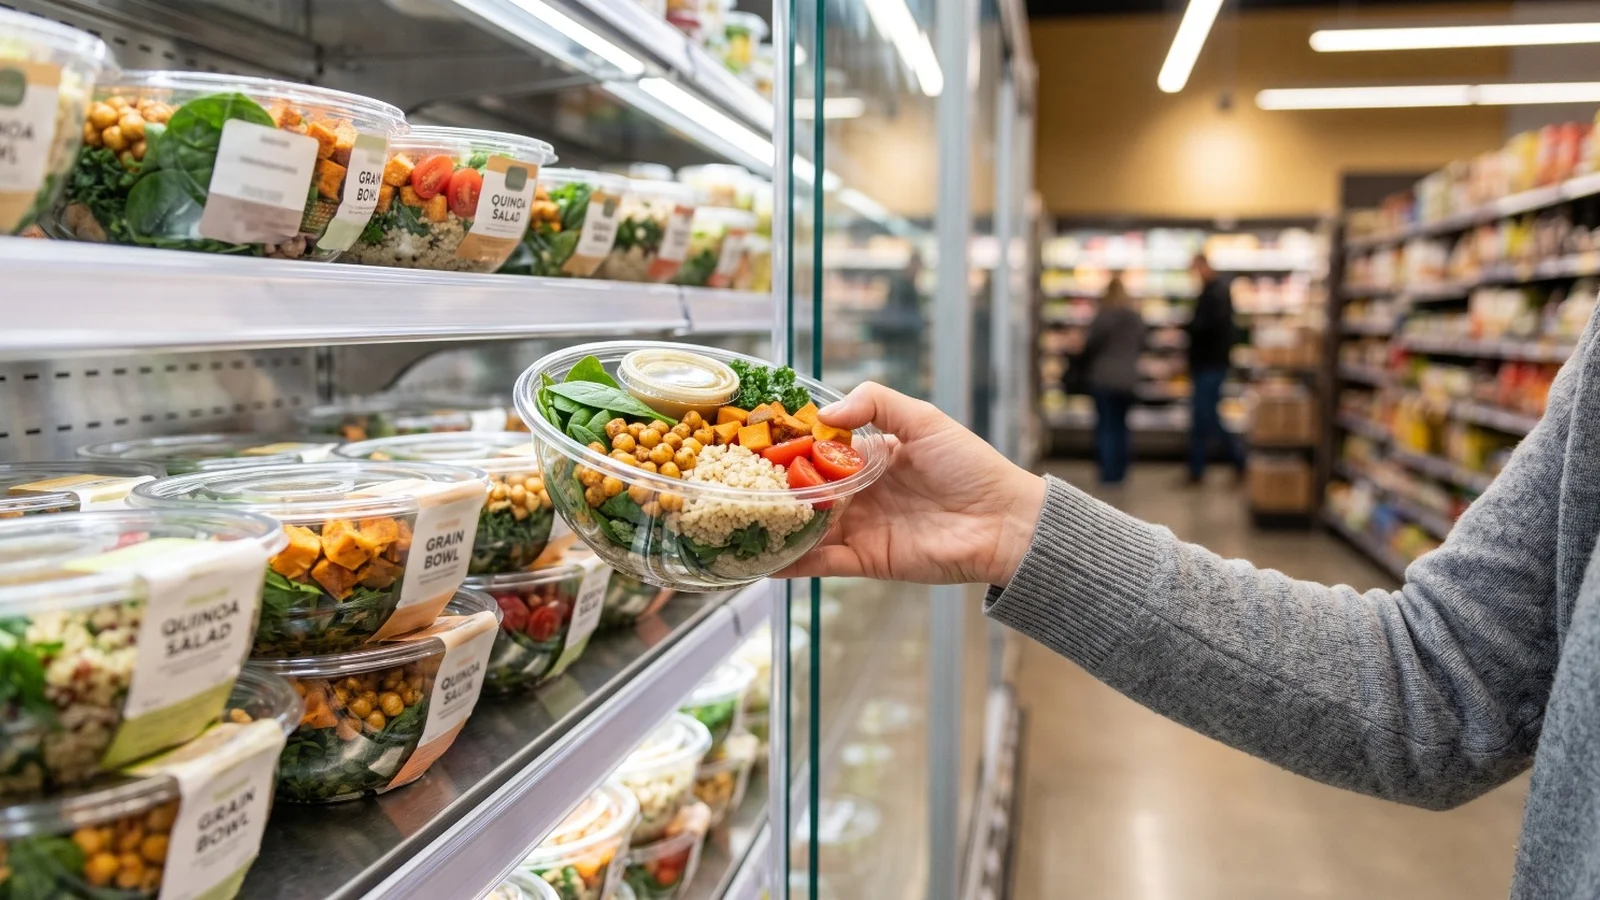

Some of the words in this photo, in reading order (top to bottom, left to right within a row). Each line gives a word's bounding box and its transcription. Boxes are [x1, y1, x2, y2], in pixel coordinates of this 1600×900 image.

[491, 194, 526, 209] QUINOA
[492, 208, 521, 222] SALAD
[426, 529, 465, 552] GRAIN
[424, 548, 459, 570] BOWL
[161, 600, 240, 638] QUINOA
[165, 622, 233, 659] SALAD
[197, 785, 257, 832] GRAIN
[195, 811, 249, 854] BOWL
